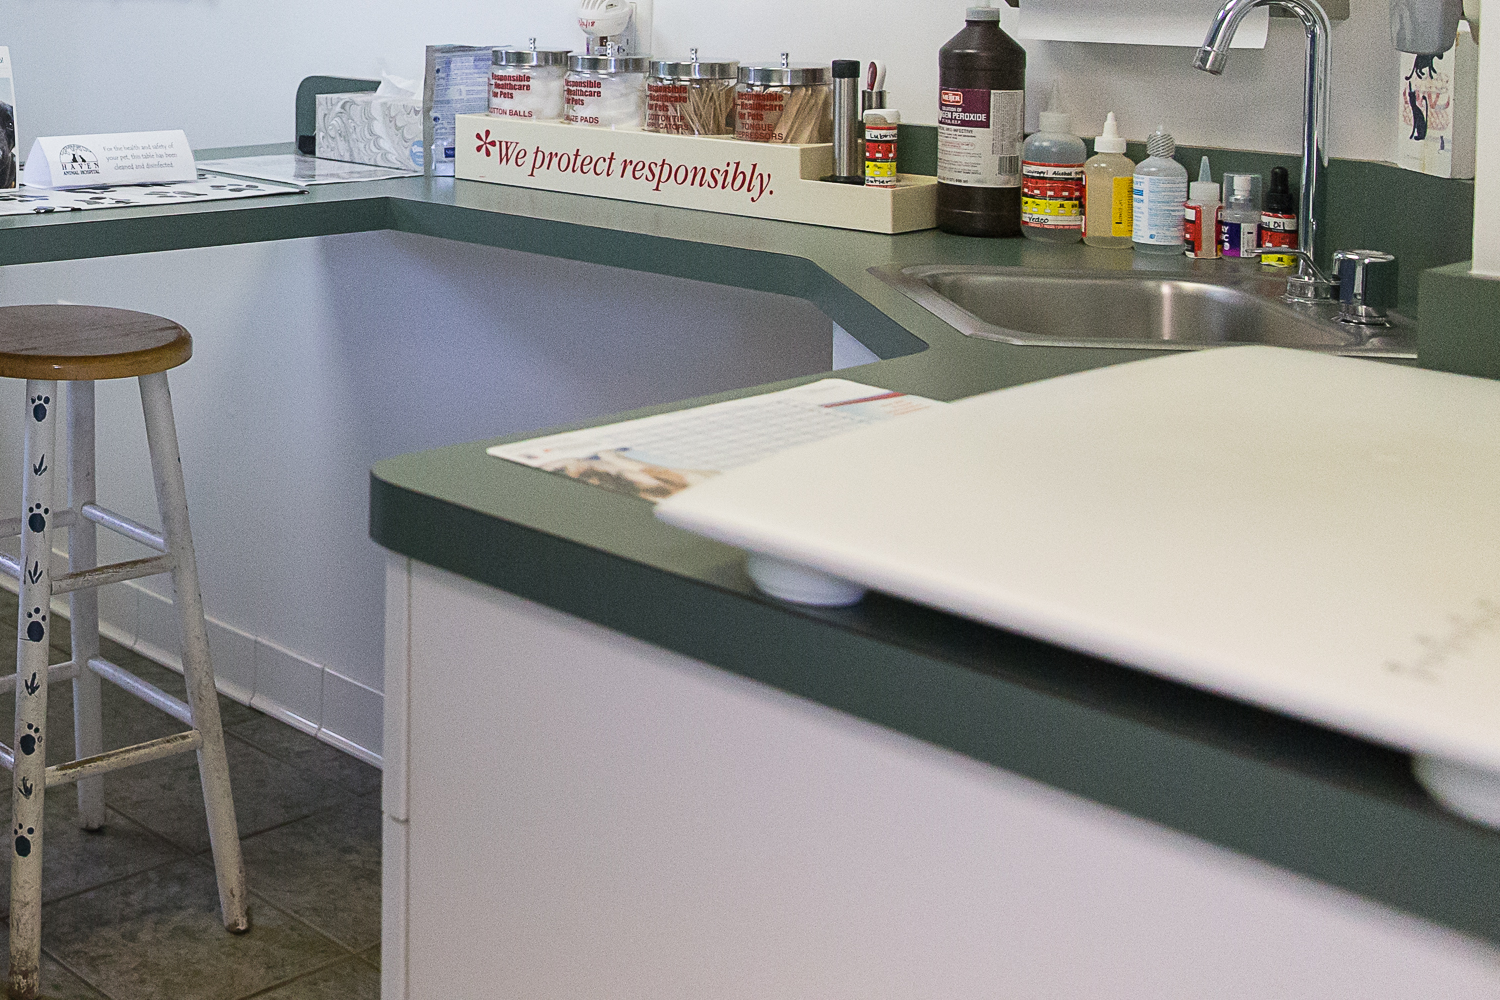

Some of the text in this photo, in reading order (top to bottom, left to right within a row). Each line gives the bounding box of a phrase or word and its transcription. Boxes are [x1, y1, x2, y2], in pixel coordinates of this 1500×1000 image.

[491, 72, 531, 83] Responsible
[494, 82, 530, 91] Healthcare
[500, 91, 514, 100] Pets
[572, 97, 584, 106] Pets
[654, 102, 669, 112] Pets
[509, 109, 533, 118] BALLS
[748, 112, 764, 122] Pets
[952, 112, 987, 122] PEROXIDE
[580, 116, 600, 124] PADS
[742, 123, 773, 132] TONGUE
[62, 162, 100, 171] HAVEN
[528, 146, 617, 178] protect
[620, 158, 774, 203] responsibly.
